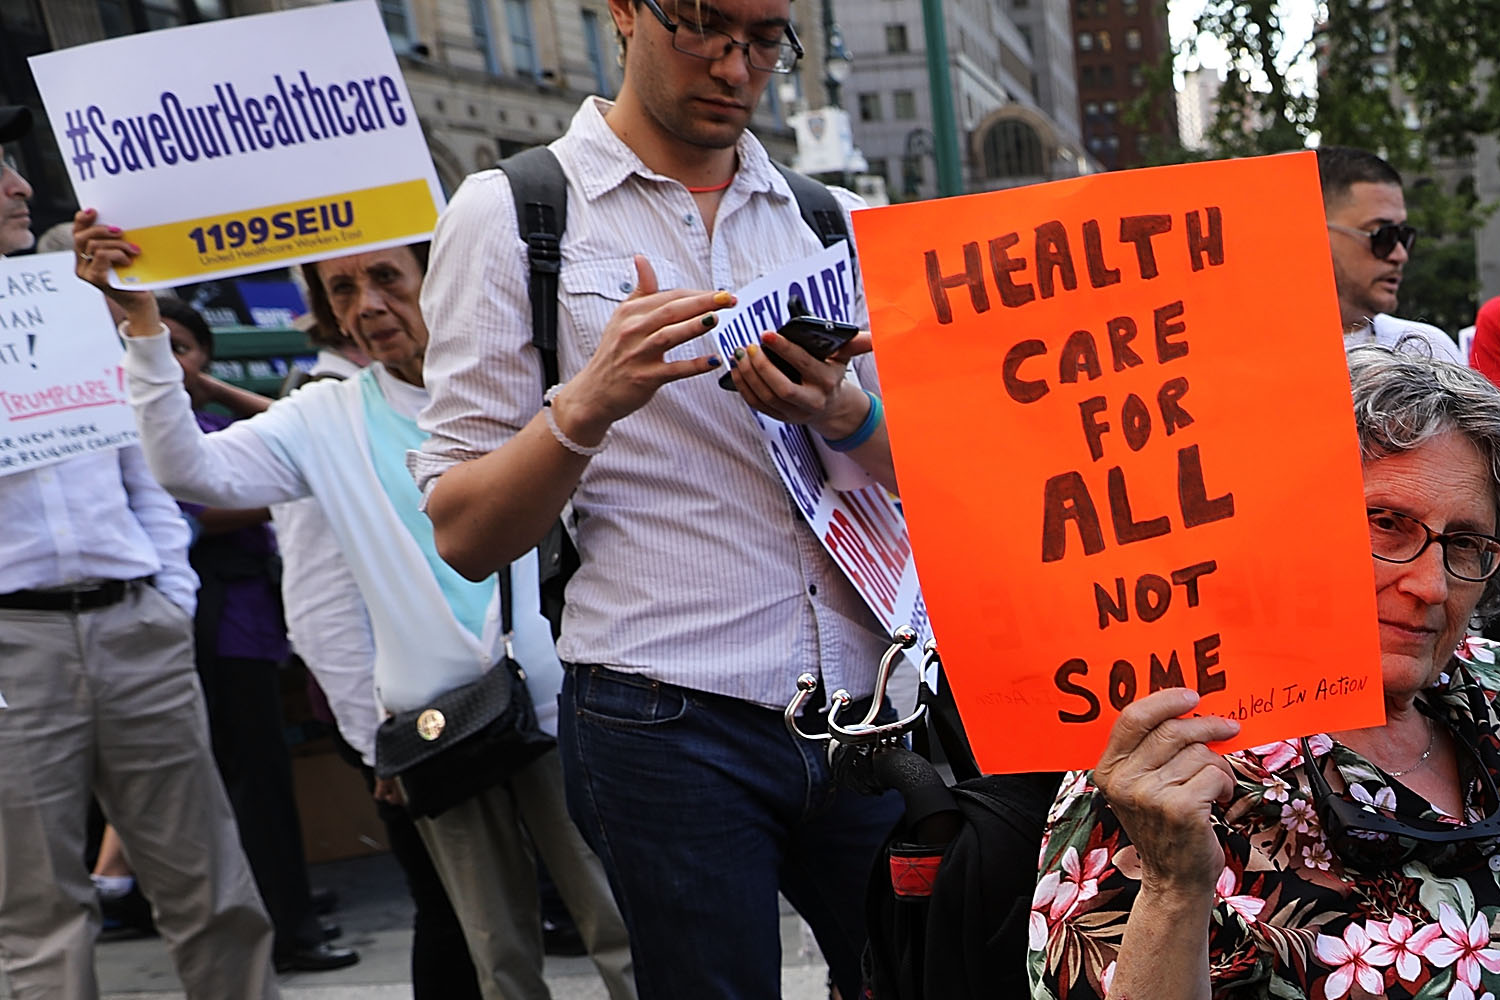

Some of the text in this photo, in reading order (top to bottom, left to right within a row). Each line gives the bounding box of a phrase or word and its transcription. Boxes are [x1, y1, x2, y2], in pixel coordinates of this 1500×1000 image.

[65, 70, 407, 182] #SaveOurHealthcare
[188, 200, 355, 254] 1199SEIU
[924, 206, 1225, 325] HEALTH
[0, 270, 58, 298] ARE
[1002, 300, 1189, 404] CARE
[1078, 376, 1195, 462] FOR
[1041, 444, 1236, 563] ALL
[1094, 560, 1216, 630] NOT
[1054, 633, 1227, 724] SOME
